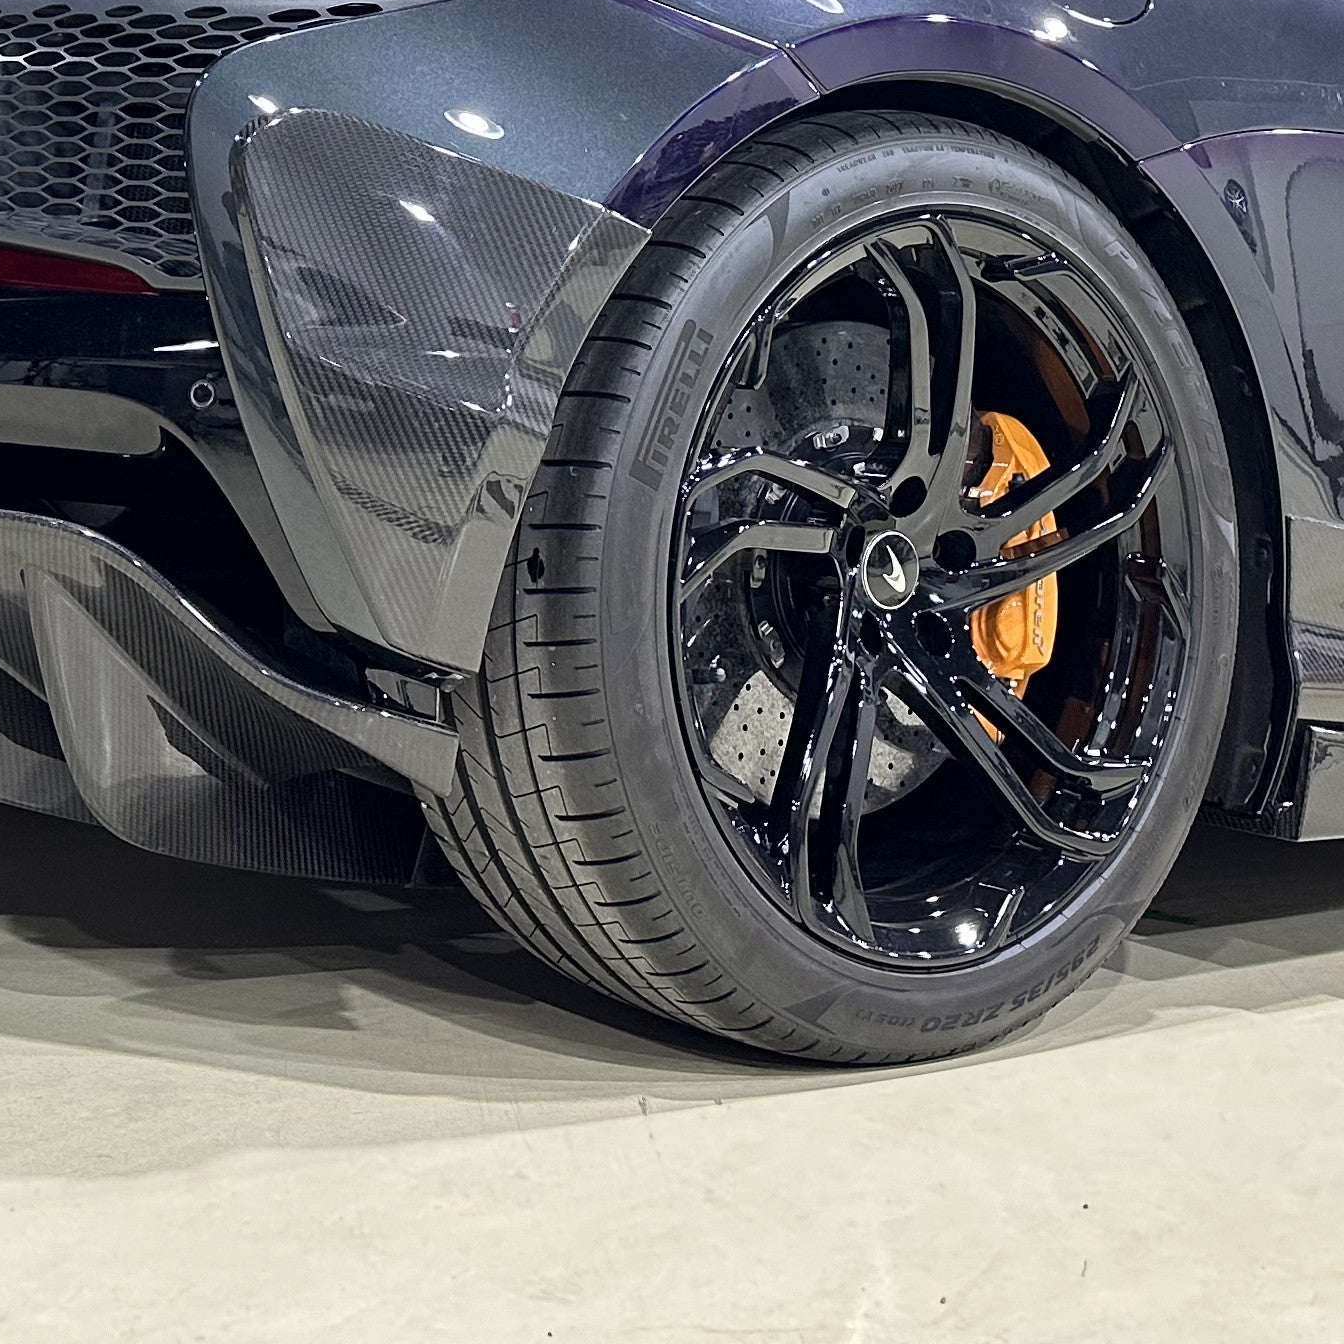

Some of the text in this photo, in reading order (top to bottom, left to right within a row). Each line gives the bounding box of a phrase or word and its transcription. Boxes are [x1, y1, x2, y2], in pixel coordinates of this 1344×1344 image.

[628, 319, 715, 491] PIRELLI
[1008, 932, 1101, 1013] 295/35
[919, 1001, 1007, 1034] ZR20
